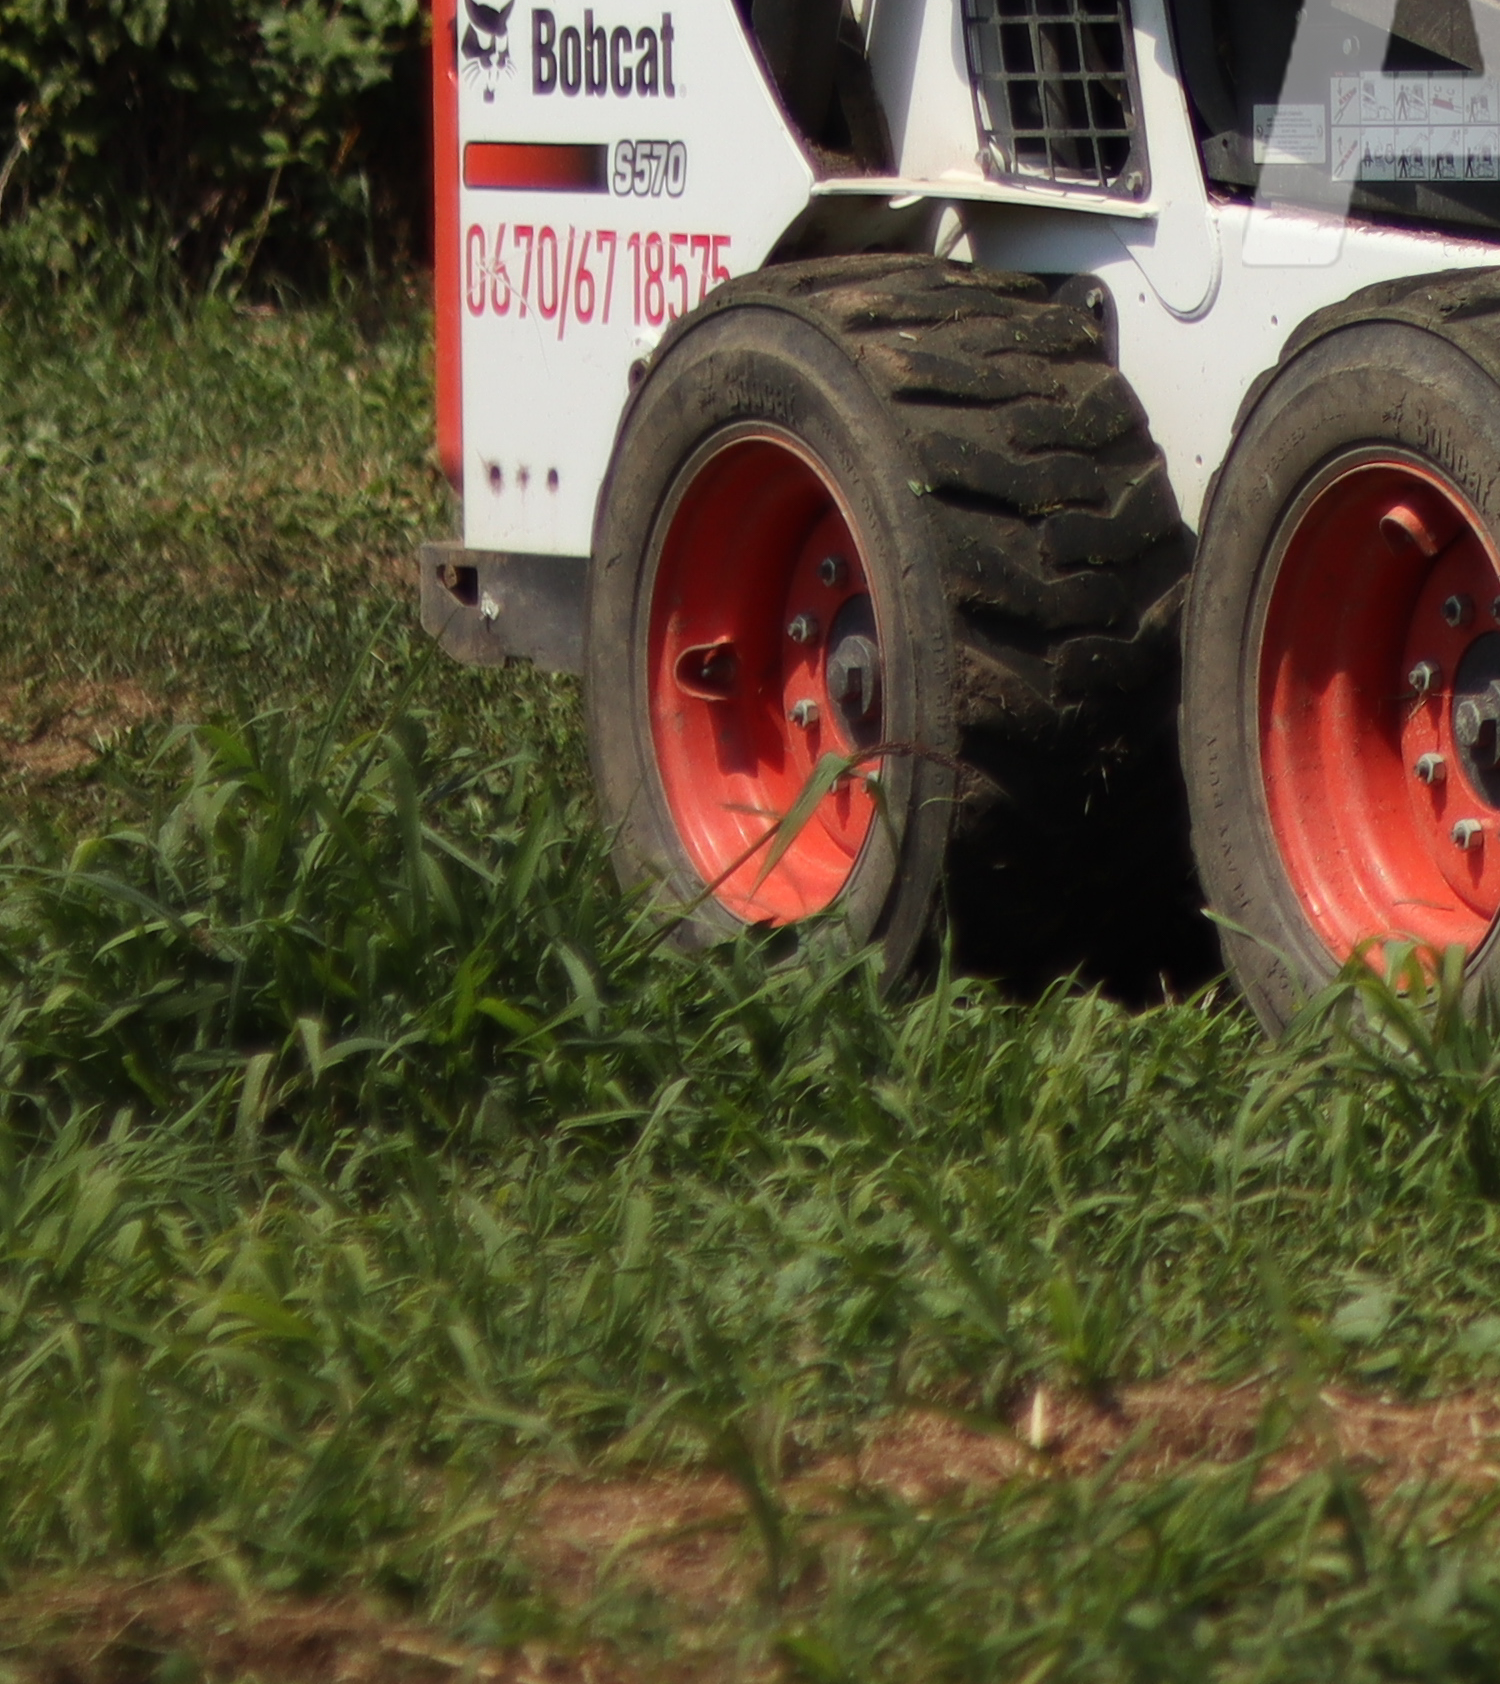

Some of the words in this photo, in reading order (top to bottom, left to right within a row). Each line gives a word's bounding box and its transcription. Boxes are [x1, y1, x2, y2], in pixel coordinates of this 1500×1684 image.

[531, 8, 676, 99] Bobcat
[613, 140, 687, 198] S570
[1414, 400, 1497, 515] Bobcat
